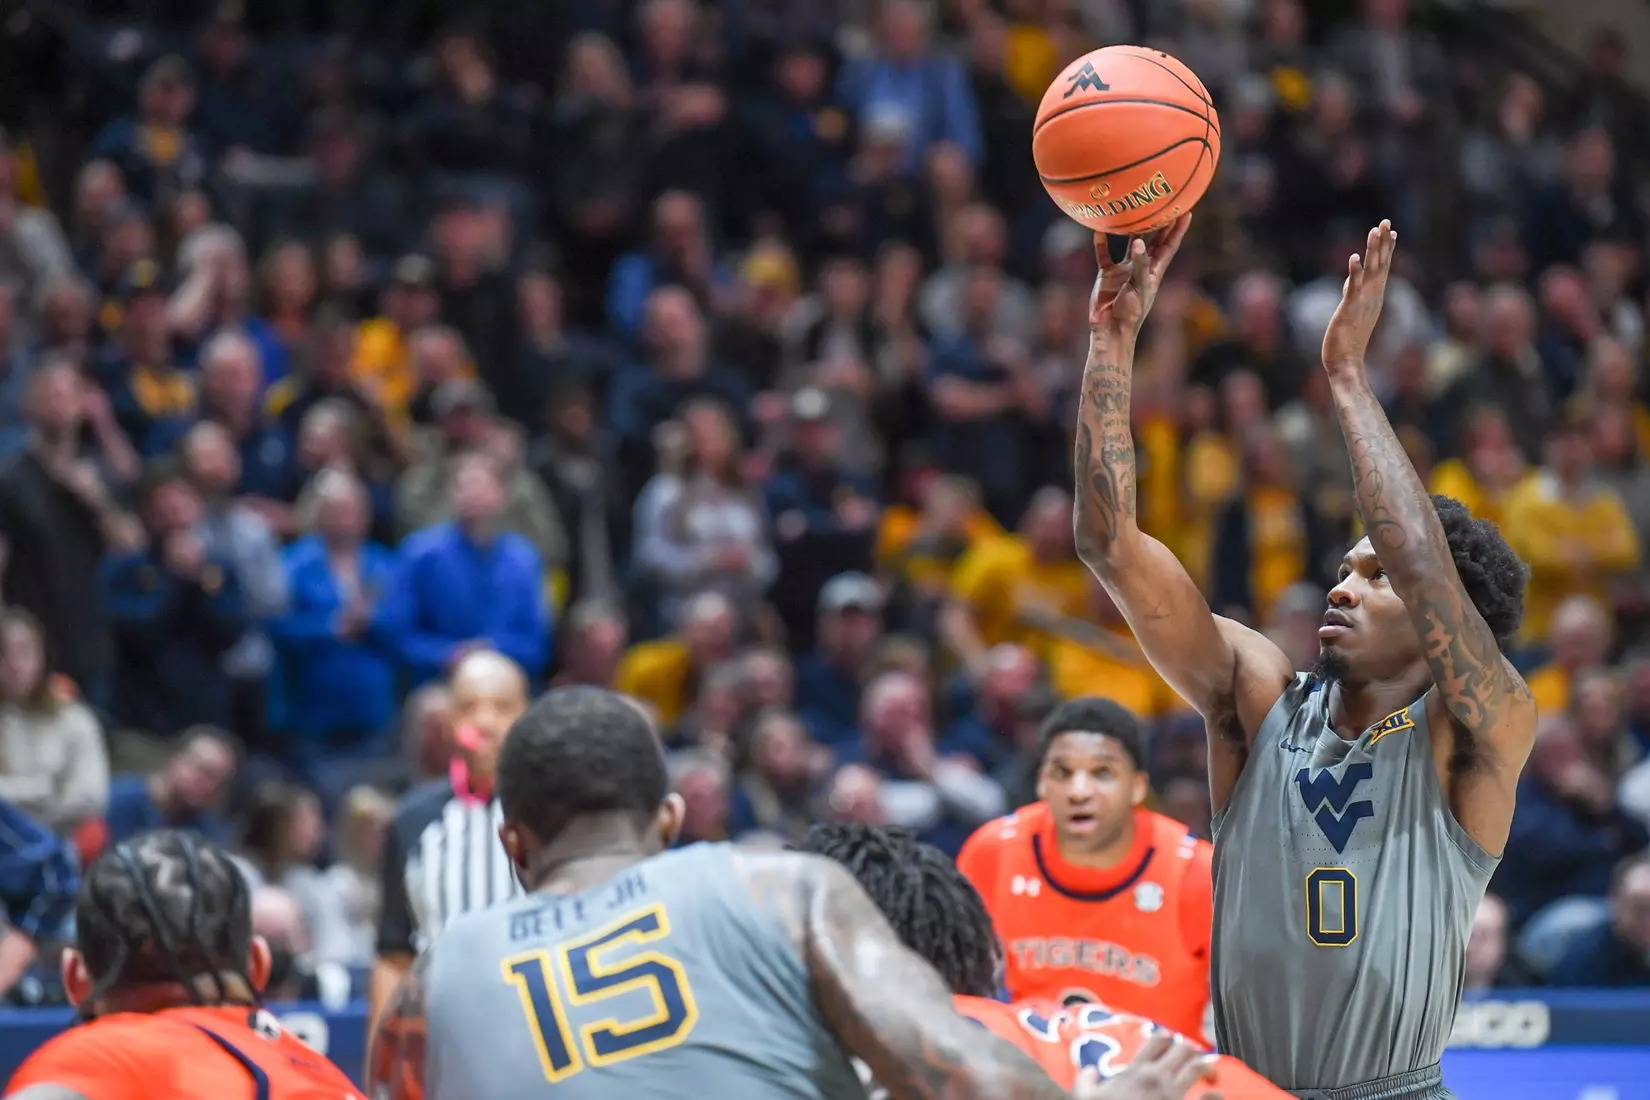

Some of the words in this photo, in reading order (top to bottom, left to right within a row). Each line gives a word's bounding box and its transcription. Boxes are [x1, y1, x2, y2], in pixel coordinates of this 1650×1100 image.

[1056, 170, 1173, 220] PALDING
[1305, 866, 1359, 947] 0
[501, 902, 698, 1083] 15
[1009, 937, 1162, 987] TIGERS
